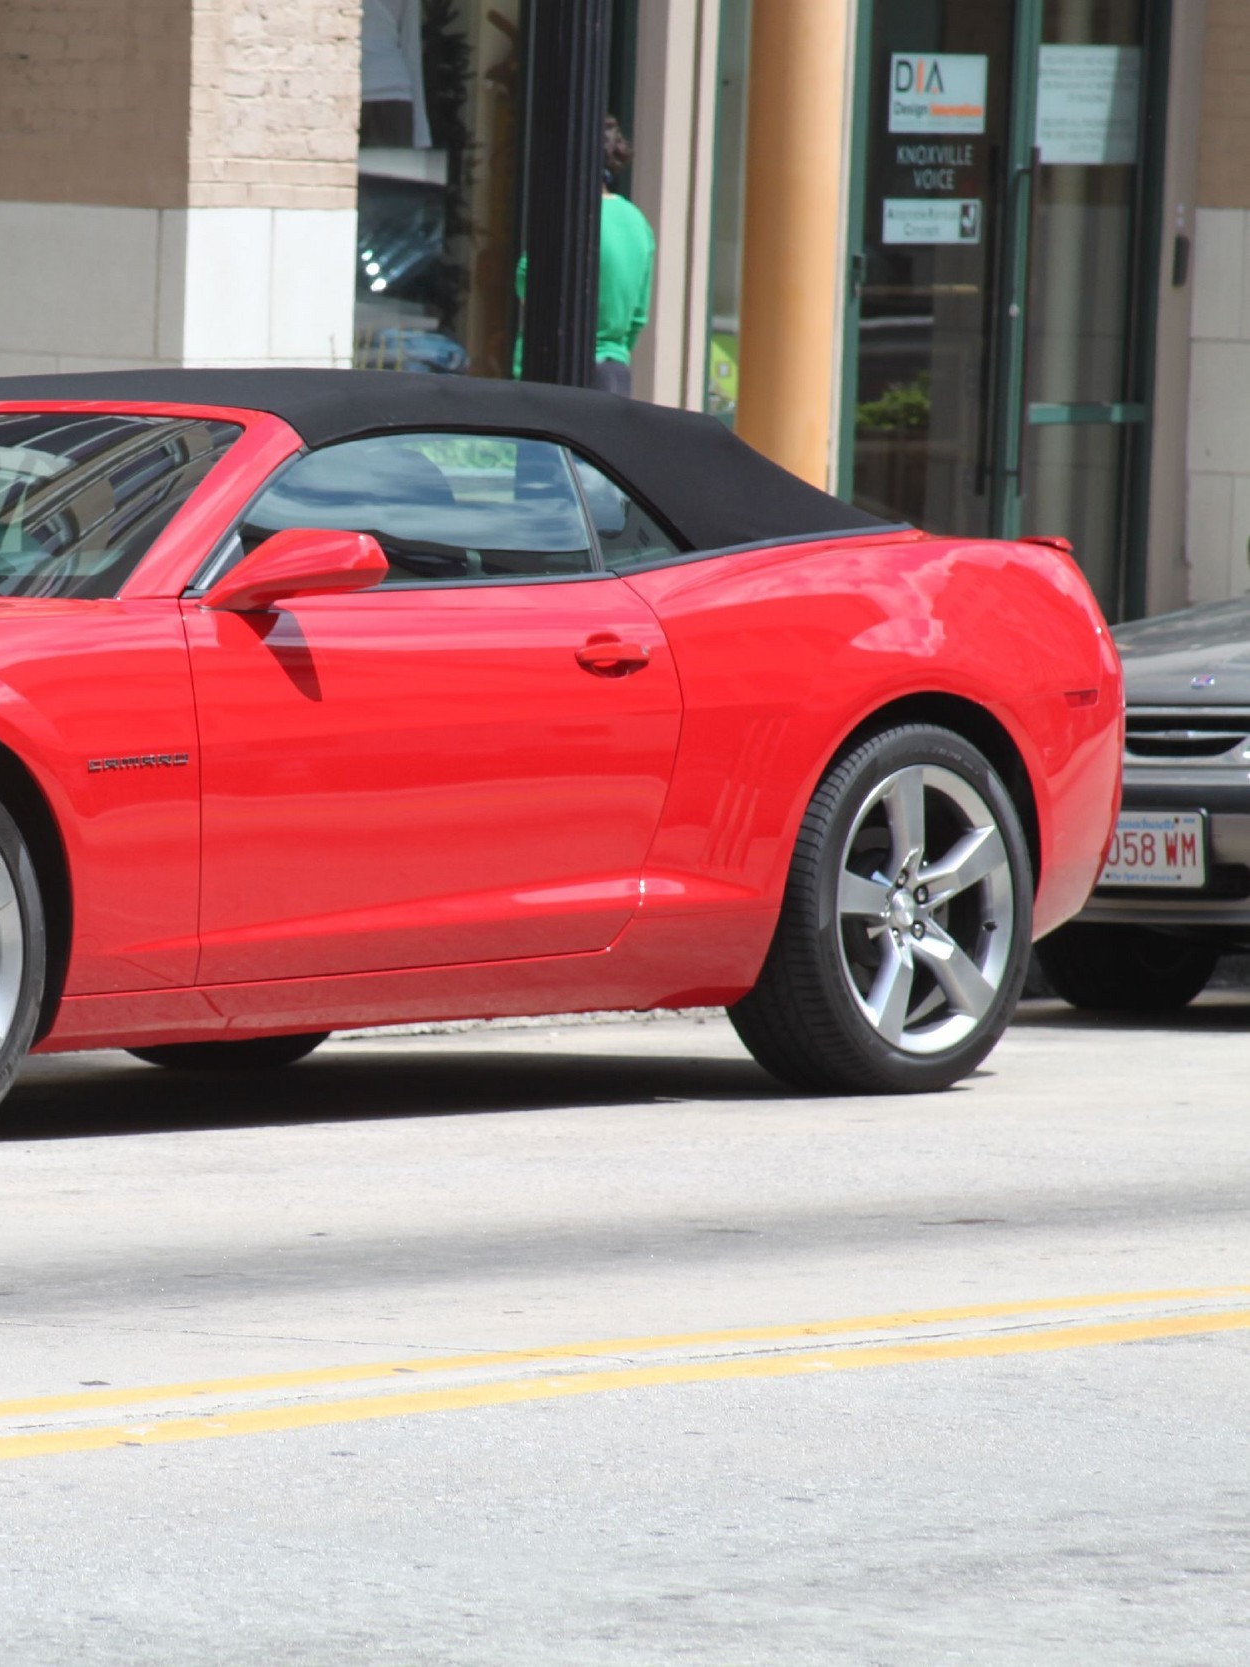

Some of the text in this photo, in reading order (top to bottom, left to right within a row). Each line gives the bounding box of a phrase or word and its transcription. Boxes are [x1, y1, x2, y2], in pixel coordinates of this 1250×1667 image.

[896, 58, 944, 94] DIA
[896, 144, 974, 166] KNOXVILLE
[912, 168, 956, 190] VOICE
[88, 753, 190, 772] CAMARO
[1164, 831, 1197, 868] WM
